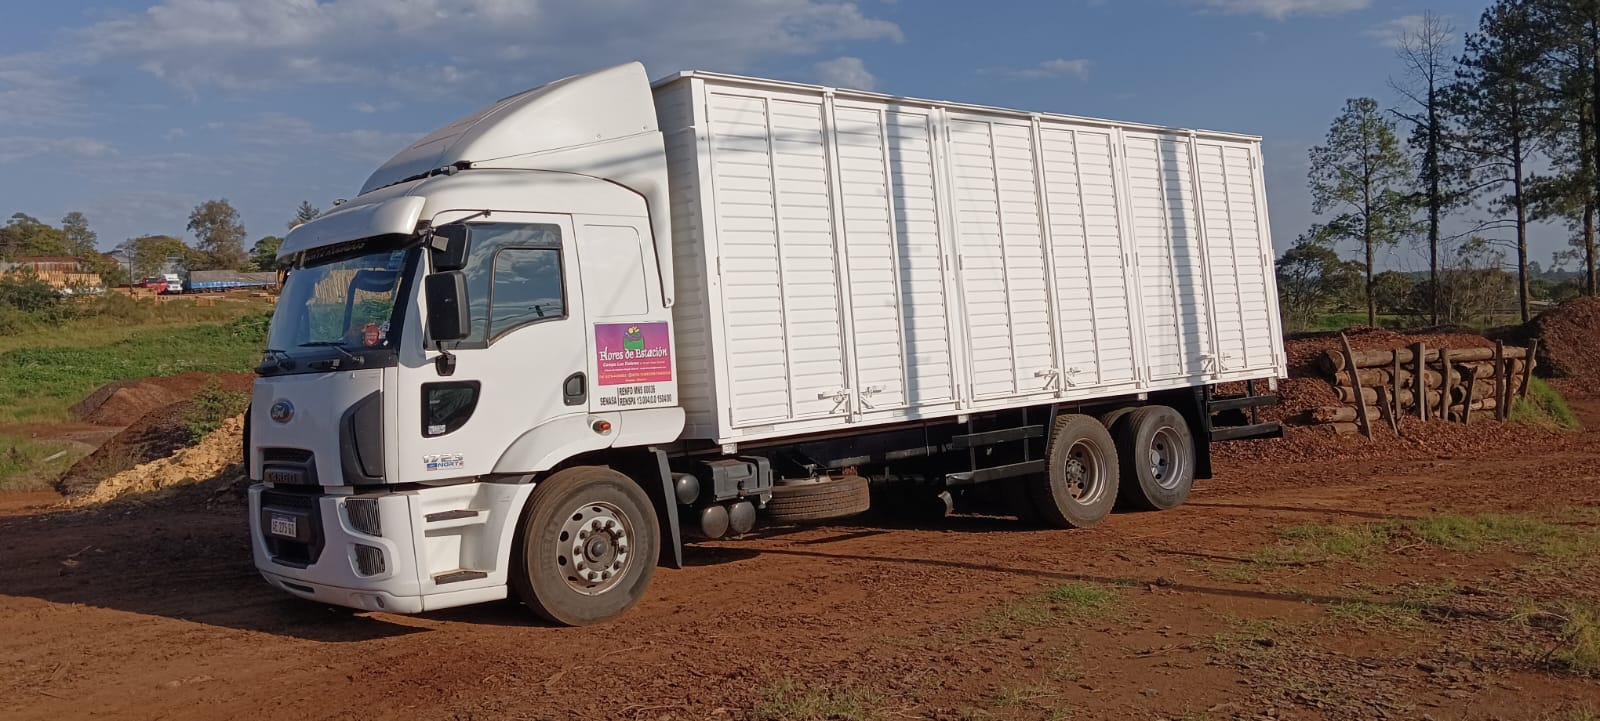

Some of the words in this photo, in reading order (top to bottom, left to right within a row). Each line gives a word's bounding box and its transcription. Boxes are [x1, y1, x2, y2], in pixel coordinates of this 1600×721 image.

[599, 346, 623, 361] Flores
[625, 349, 634, 359] de
[635, 346, 668, 359] Estación
[600, 395, 617, 406] SENASA
[619, 396, 636, 407] RENSPA
